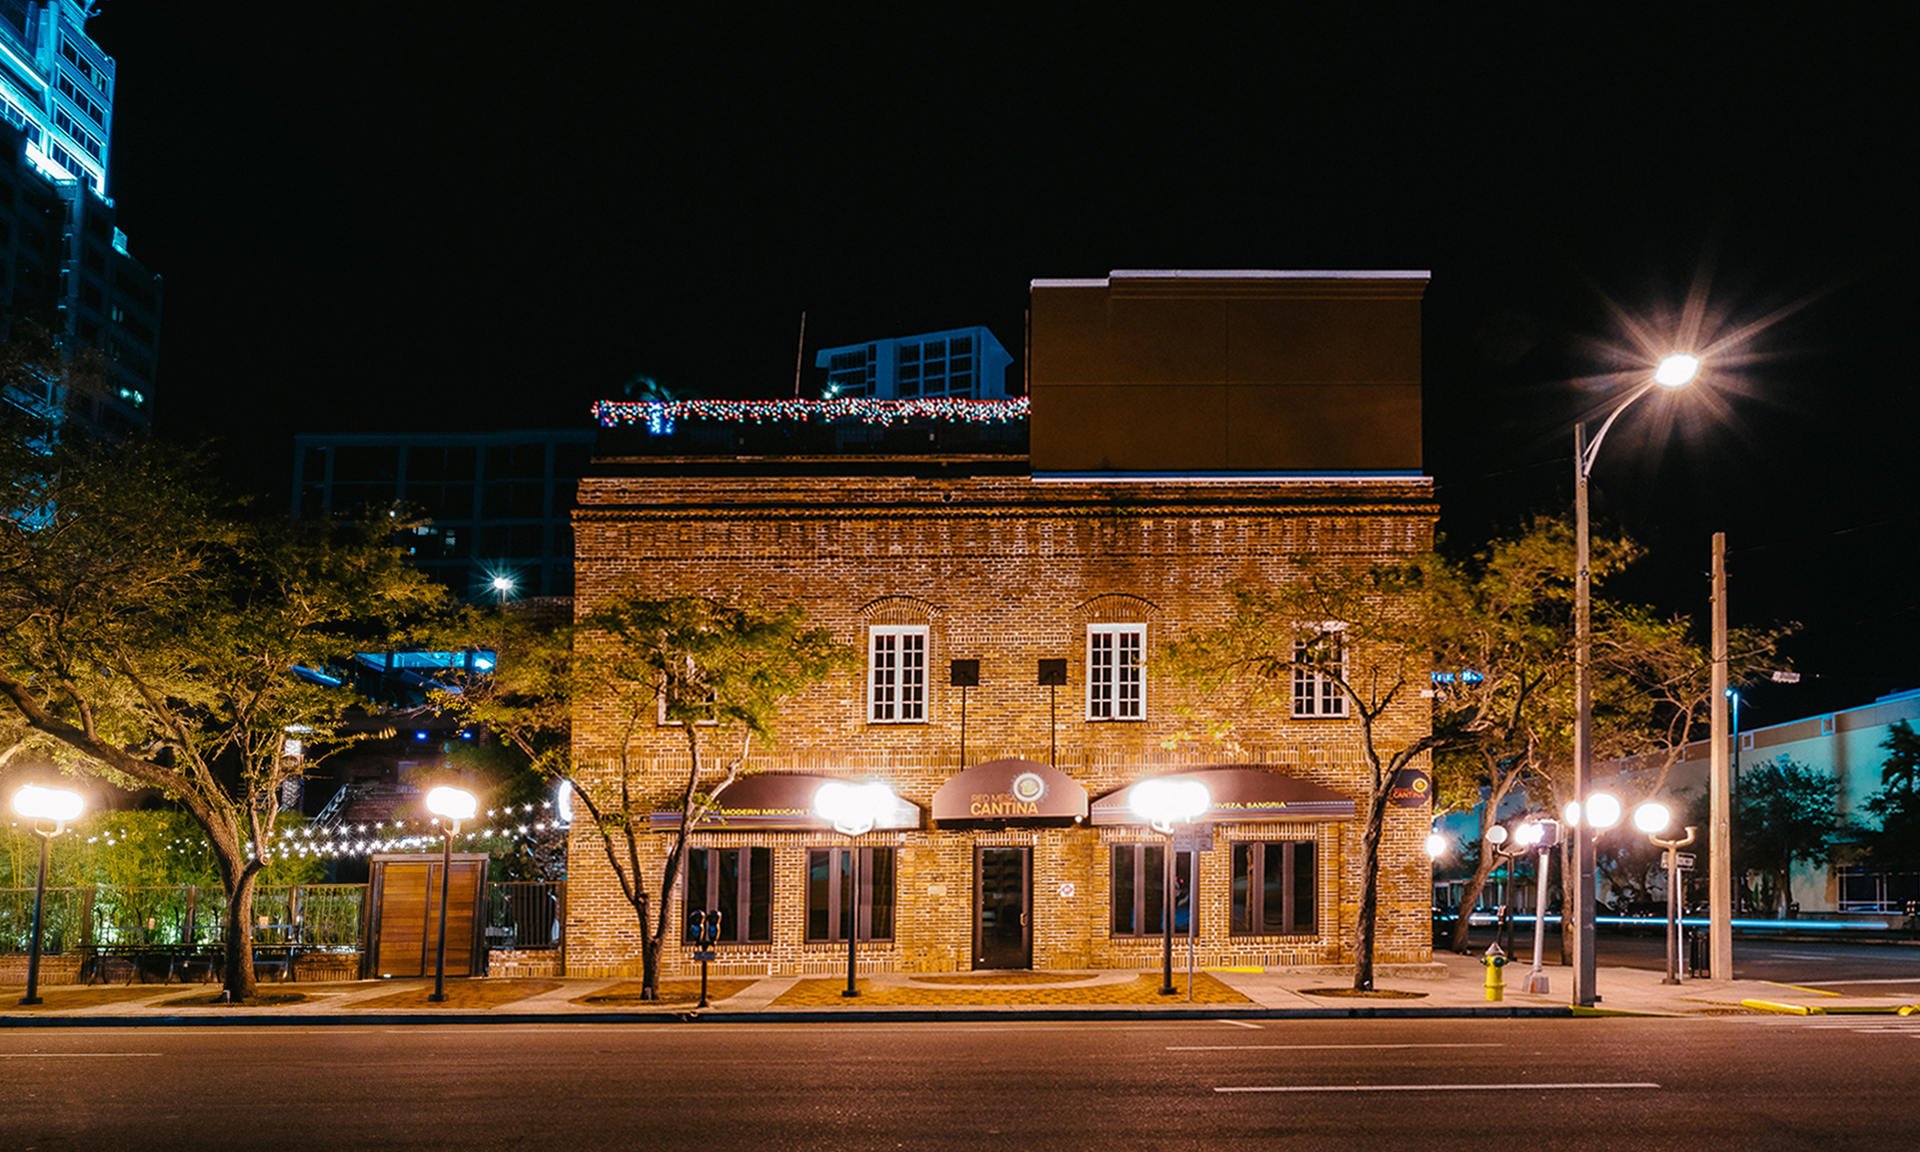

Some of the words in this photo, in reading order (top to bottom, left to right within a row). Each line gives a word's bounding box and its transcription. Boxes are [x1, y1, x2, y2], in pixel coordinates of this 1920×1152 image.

[971, 793, 990, 803] RED
[991, 793, 1017, 803] MESA
[1392, 791, 1426, 799] CANTINA
[970, 802, 1039, 816] CANTINA
[1246, 802, 1287, 810] SANGRIA
[721, 808, 760, 816] MODERN
[762, 808, 805, 816] MEXICAN
